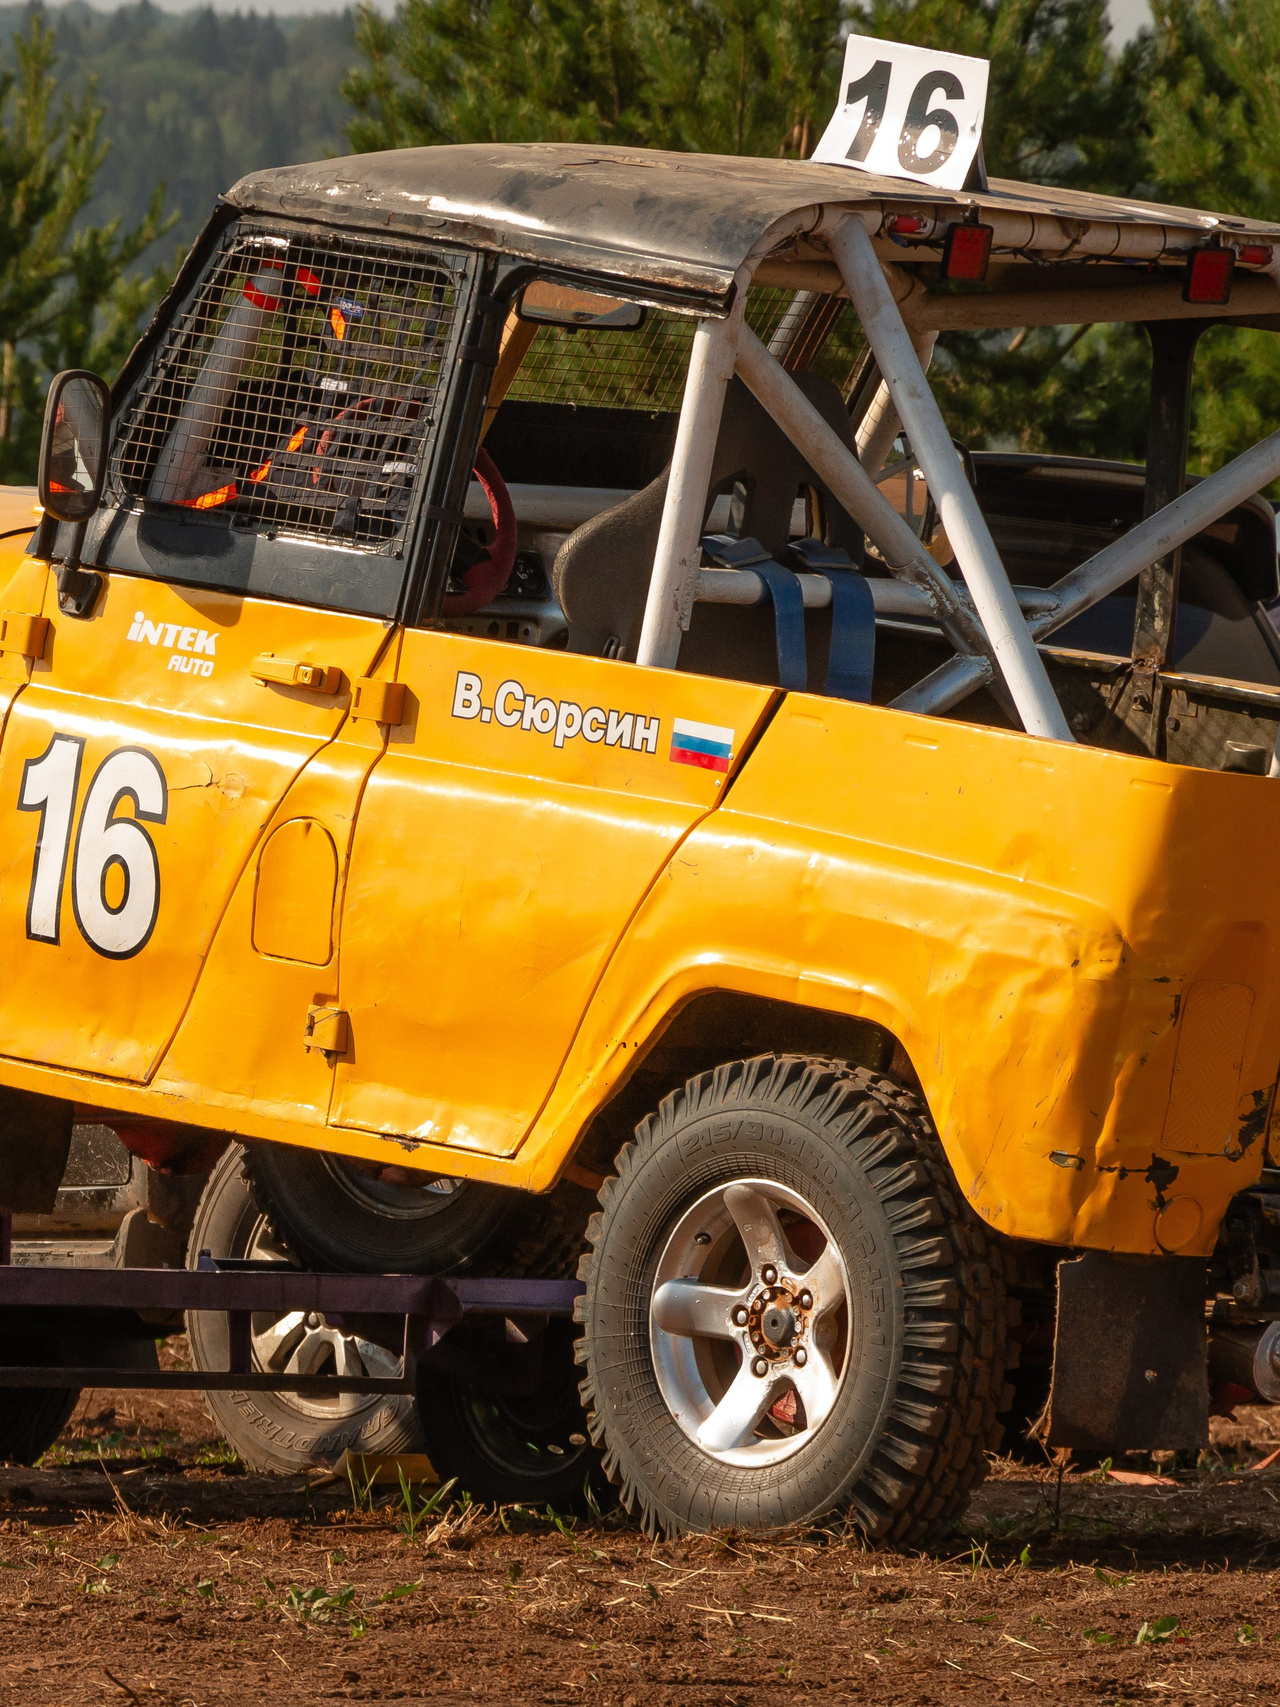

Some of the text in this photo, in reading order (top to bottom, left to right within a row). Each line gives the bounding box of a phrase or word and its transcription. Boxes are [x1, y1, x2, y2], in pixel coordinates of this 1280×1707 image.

[846, 59, 965, 175] 16
[167, 654, 215, 677] AUTO
[451, 670, 660, 755] В.Сюрсин
[17, 732, 168, 961] 16
